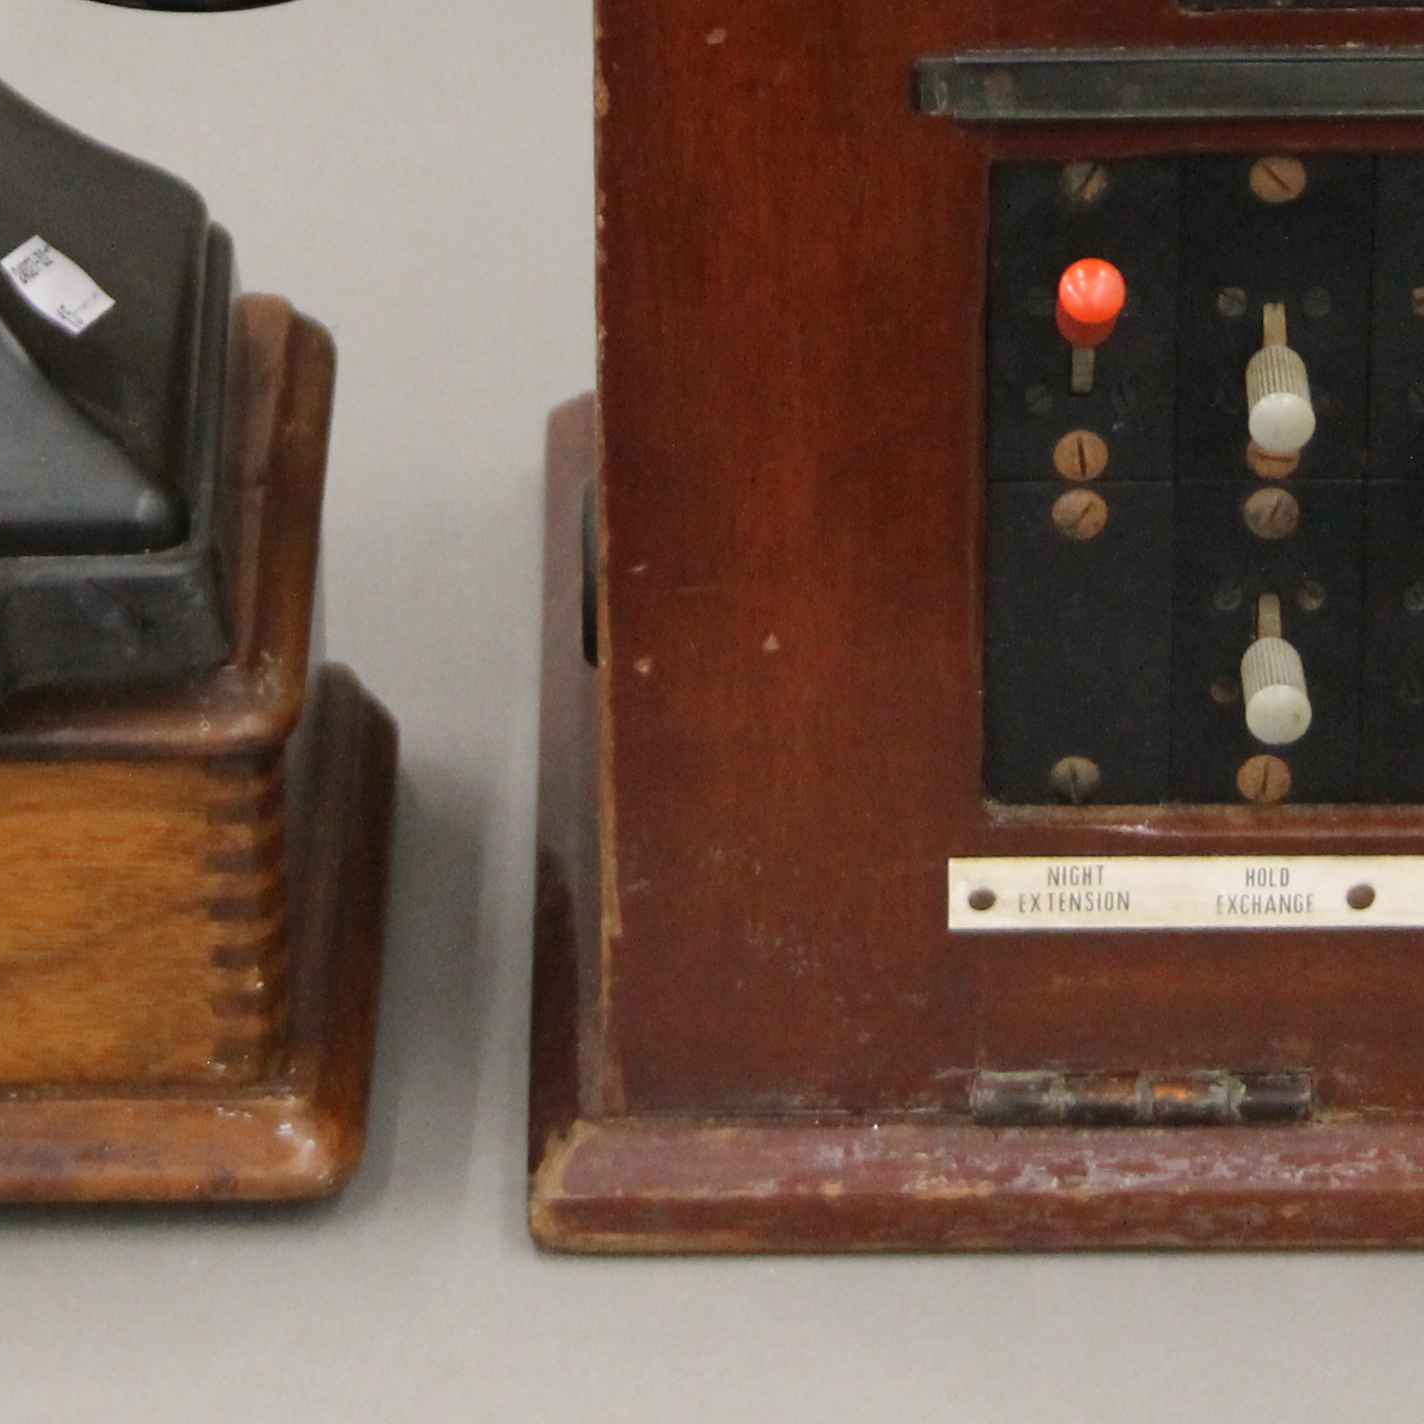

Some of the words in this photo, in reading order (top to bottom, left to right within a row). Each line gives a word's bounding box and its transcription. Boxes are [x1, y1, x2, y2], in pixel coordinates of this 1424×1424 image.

[1047, 864, 1106, 887] NIGHT
[1245, 866, 1291, 888] HOLD
[1017, 891, 1131, 914] EXTENSION
[1216, 893, 1314, 915] EXCHANGE
